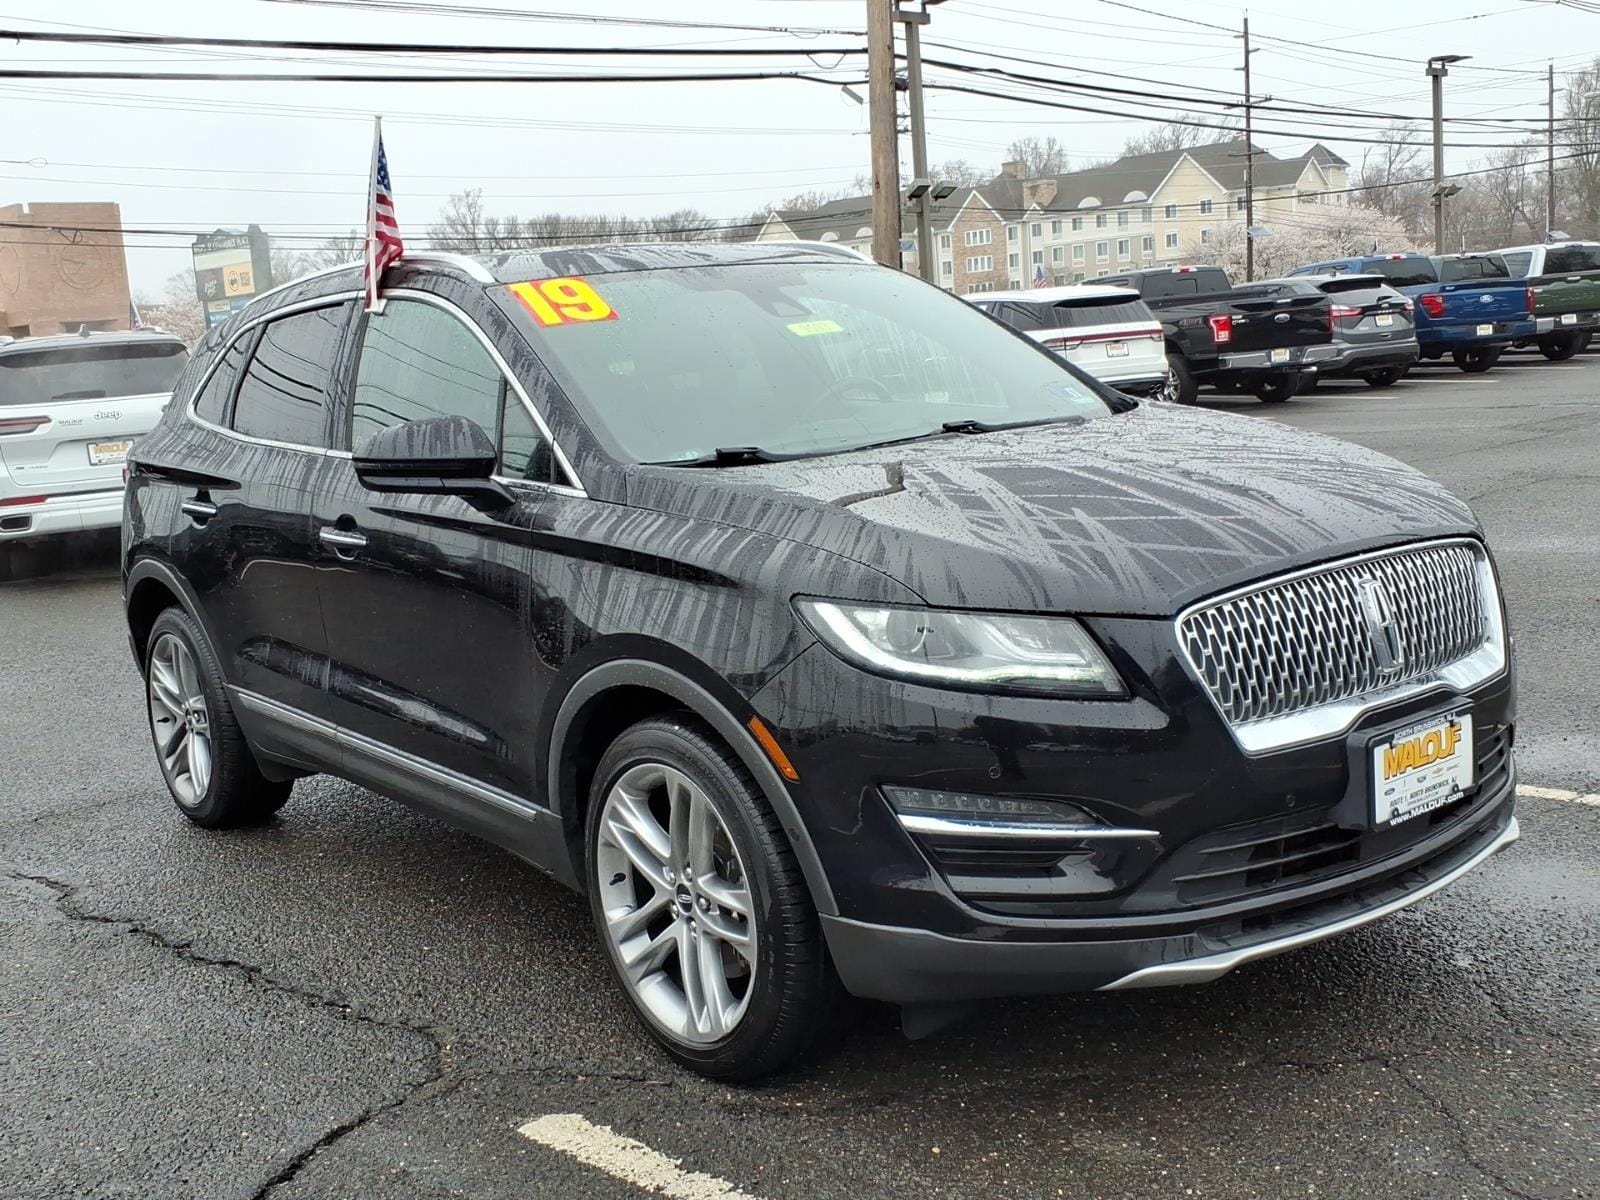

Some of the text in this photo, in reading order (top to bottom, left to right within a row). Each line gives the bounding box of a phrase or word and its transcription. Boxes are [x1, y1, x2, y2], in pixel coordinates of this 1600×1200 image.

[509, 277, 613, 326] 19
[95, 410, 121, 420] Jeep
[1384, 721, 1462, 781] MALOUF
[1389, 792, 1464, 826] www.MALOUF.com
